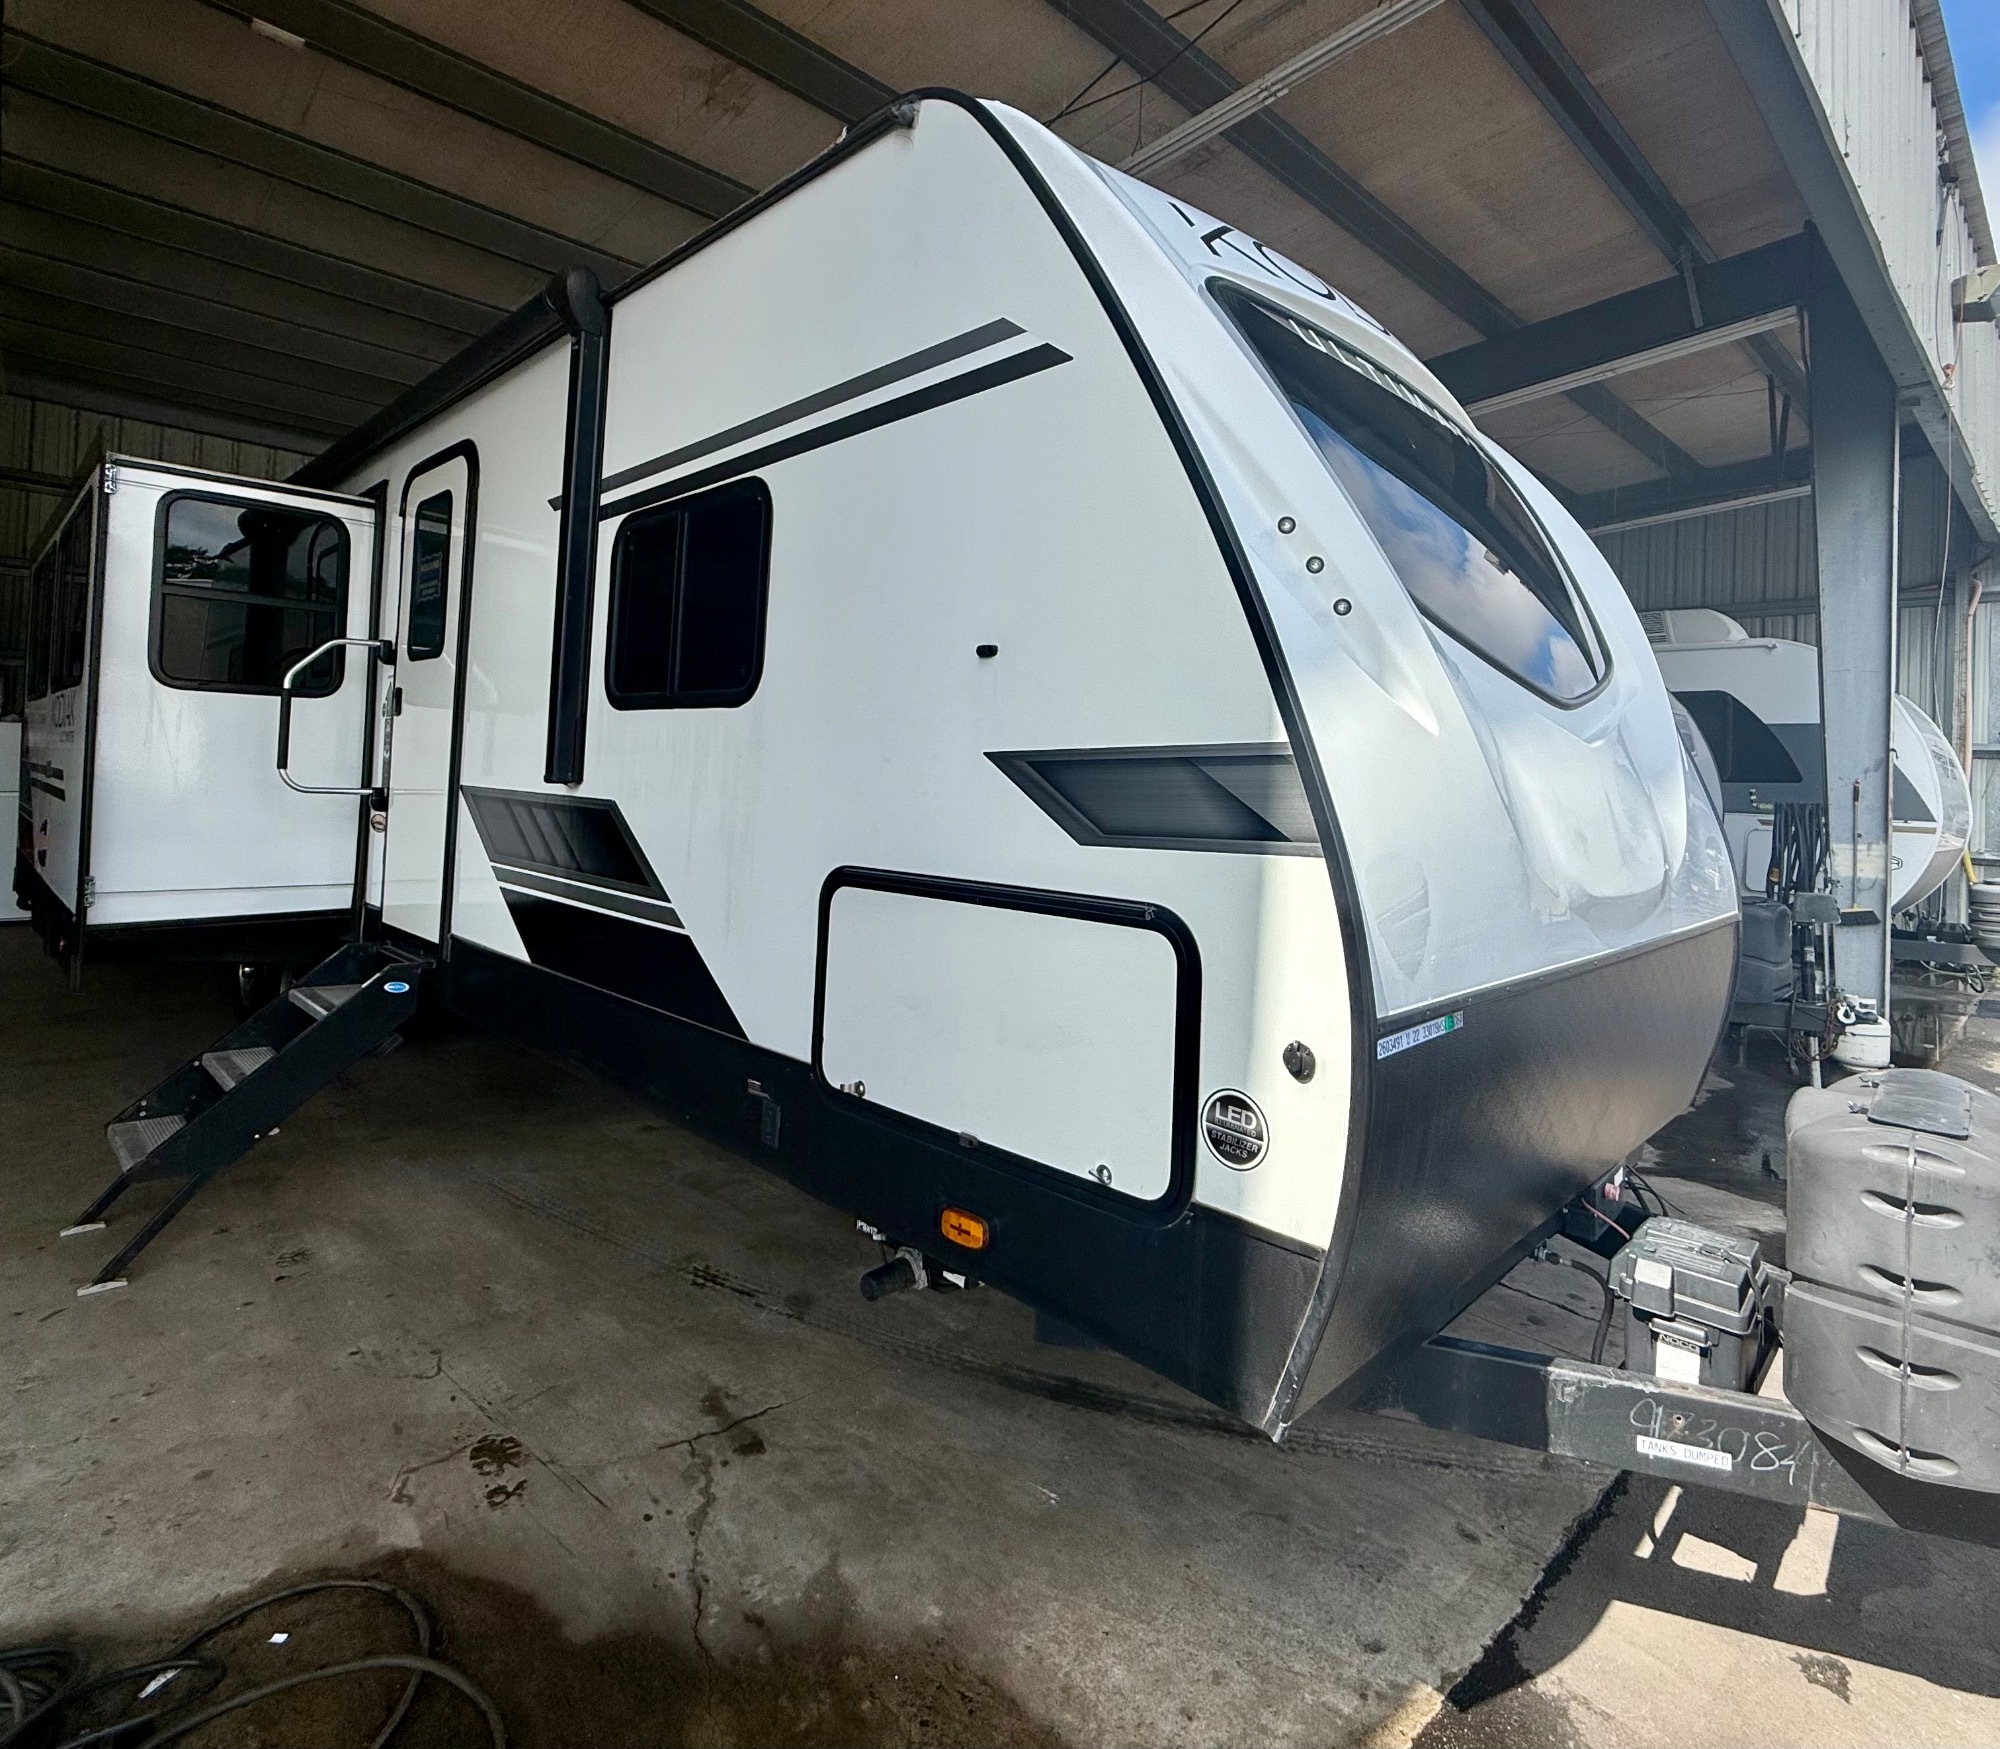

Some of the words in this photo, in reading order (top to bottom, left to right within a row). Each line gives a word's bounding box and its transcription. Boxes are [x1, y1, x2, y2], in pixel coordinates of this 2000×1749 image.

[1412, 1028, 1421, 1043] 22
[1215, 1101, 1257, 1130] LED
[1211, 1130, 1259, 1153] STABILIZER
[1219, 1143, 1248, 1158] JACKS
[1659, 1334, 1699, 1351] NOCO
[1640, 1439, 1677, 1456] TANKS
[1683, 1446, 1730, 1466] DUMPED
